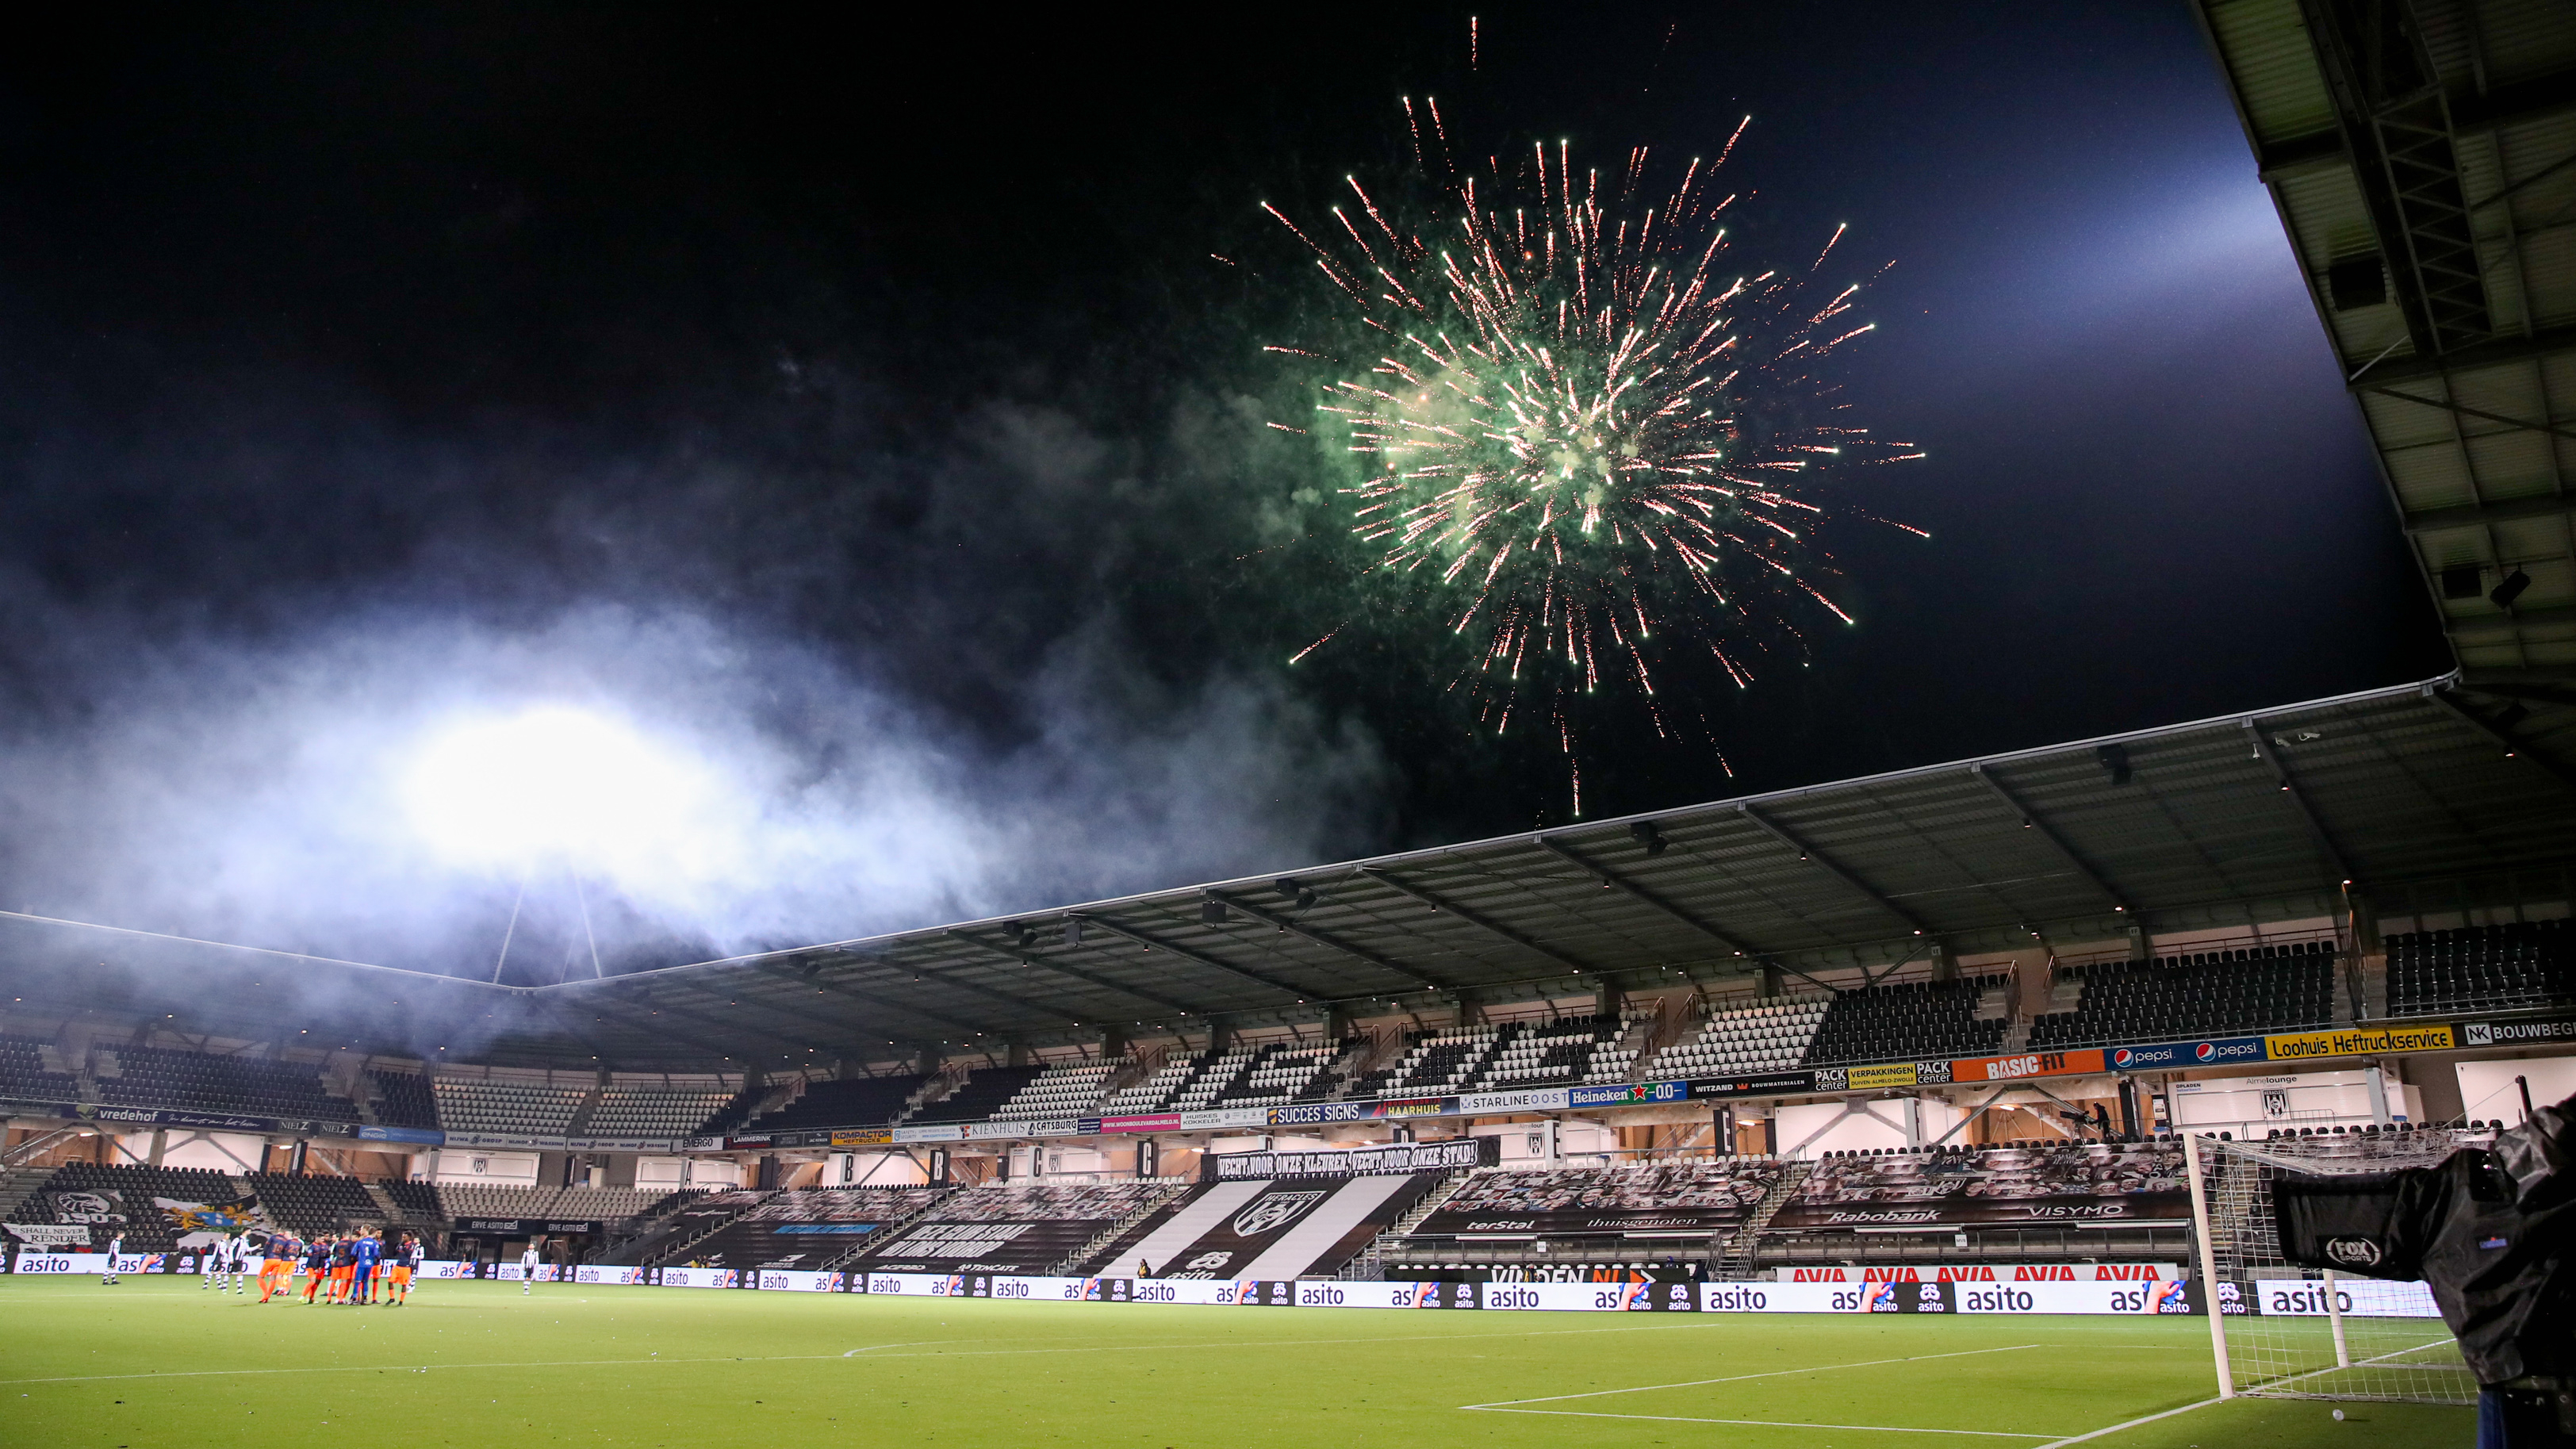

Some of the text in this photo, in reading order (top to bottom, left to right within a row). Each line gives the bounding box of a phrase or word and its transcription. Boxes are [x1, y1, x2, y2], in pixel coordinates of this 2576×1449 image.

[2467, 1025, 2489, 1041] NK
[2218, 1042, 2257, 1058] pepsi
[2272, 1029, 2448, 1057] Loohuis Heftruckservice
[2135, 1048, 2173, 1064] pepsi
[1850, 1067, 1914, 1078] VERPAKKINGEN
[1916, 1061, 1950, 1075] PACK
[1815, 1069, 1846, 1082] PACK
[1917, 1073, 1951, 1084] center
[2246, 1076, 2297, 1085] Almelounge
[1696, 1079, 1805, 1093] WITZAND BOUWMATERIALEN
[1815, 1081, 1847, 1091] center
[1473, 1092, 1568, 1108] STARLINE OOST
[1572, 1089, 1628, 1104] Heineken
[100, 1109, 158, 1122] vredehof
[1278, 1104, 1359, 1124] SUCCES SIGNS
[1388, 1105, 1441, 1117] HAARHUIS
[972, 1122, 1025, 1136] KIENHUIS
[1037, 1120, 1077, 1131] CATSBURG
[1102, 1119, 1179, 1128] WWW.WOONBOULEVARDALMELO.NL
[834, 1129, 891, 1140] KOMPACTOR
[683, 1138, 713, 1148] EMERGO
[933, 1150, 944, 1180] B
[1033, 1147, 1041, 1178] C
[1142, 1142, 1152, 1175] C
[1219, 1156, 1248, 1176] VECHT
[1250, 1155, 1274, 1175] VOOR
[1275, 1154, 1302, 1175] ONZE
[1351, 1151, 1382, 1171] VECHT
[1384, 1149, 1412, 1168] VOOR
[1412, 1147, 1440, 1166] ONZE
[1442, 1144, 1474, 1165] STAD!
[685, 1161, 692, 1186] A
[845, 1155, 853, 1183] B
[1265, 1193, 1318, 1202] HERACLES
[1827, 1209, 1942, 1222] Rabobank
[2029, 1206, 2123, 1217] VISYMO
[471, 1221, 486, 1229] ERVE
[487, 1221, 504, 1229] ASITO
[1466, 1220, 1535, 1230] terStal
[1587, 1217, 1698, 1229] thuisgenoten
[365, 1246, 370, 1256] 1
[2334, 1241, 2368, 1256] FOX
[23, 1255, 70, 1272] asito
[2340, 1254, 2372, 1263] SPORTS
[500, 1265, 519, 1279] asito
[579, 1267, 600, 1282] asito
[666, 1270, 688, 1285] asito
[1793, 1268, 1846, 1282] AVIA
[1864, 1267, 1920, 1282] AVIA
[1937, 1267, 1995, 1282] AVIA
[2014, 1266, 2076, 1281] AVIA
[2095, 1265, 2160, 1281] AVIA
[763, 1272, 788, 1289] asito
[872, 1275, 901, 1293] asito
[997, 1278, 1029, 1297] asito
[972, 1288, 987, 1297] asito
[1111, 1292, 1126, 1301] asito
[1139, 1281, 1175, 1301] asito
[1302, 1284, 1344, 1305] asito
[1491, 1285, 1539, 1307] asito
[1711, 1285, 1767, 1309] asito
[1967, 1283, 2034, 1311] asito
[1242, 1295, 1259, 1305] asito
[1271, 1295, 1287, 1305] asito
[1421, 1298, 1440, 1309] asito
[1455, 1298, 1474, 1309] asito
[1630, 1300, 1652, 1310] asito
[1668, 1300, 1690, 1311] asito
[1873, 1300, 1898, 1312] asito
[1918, 1300, 1944, 1312] asito
[2160, 1301, 2191, 1313] asito
[2221, 1301, 2245, 1313] sito
